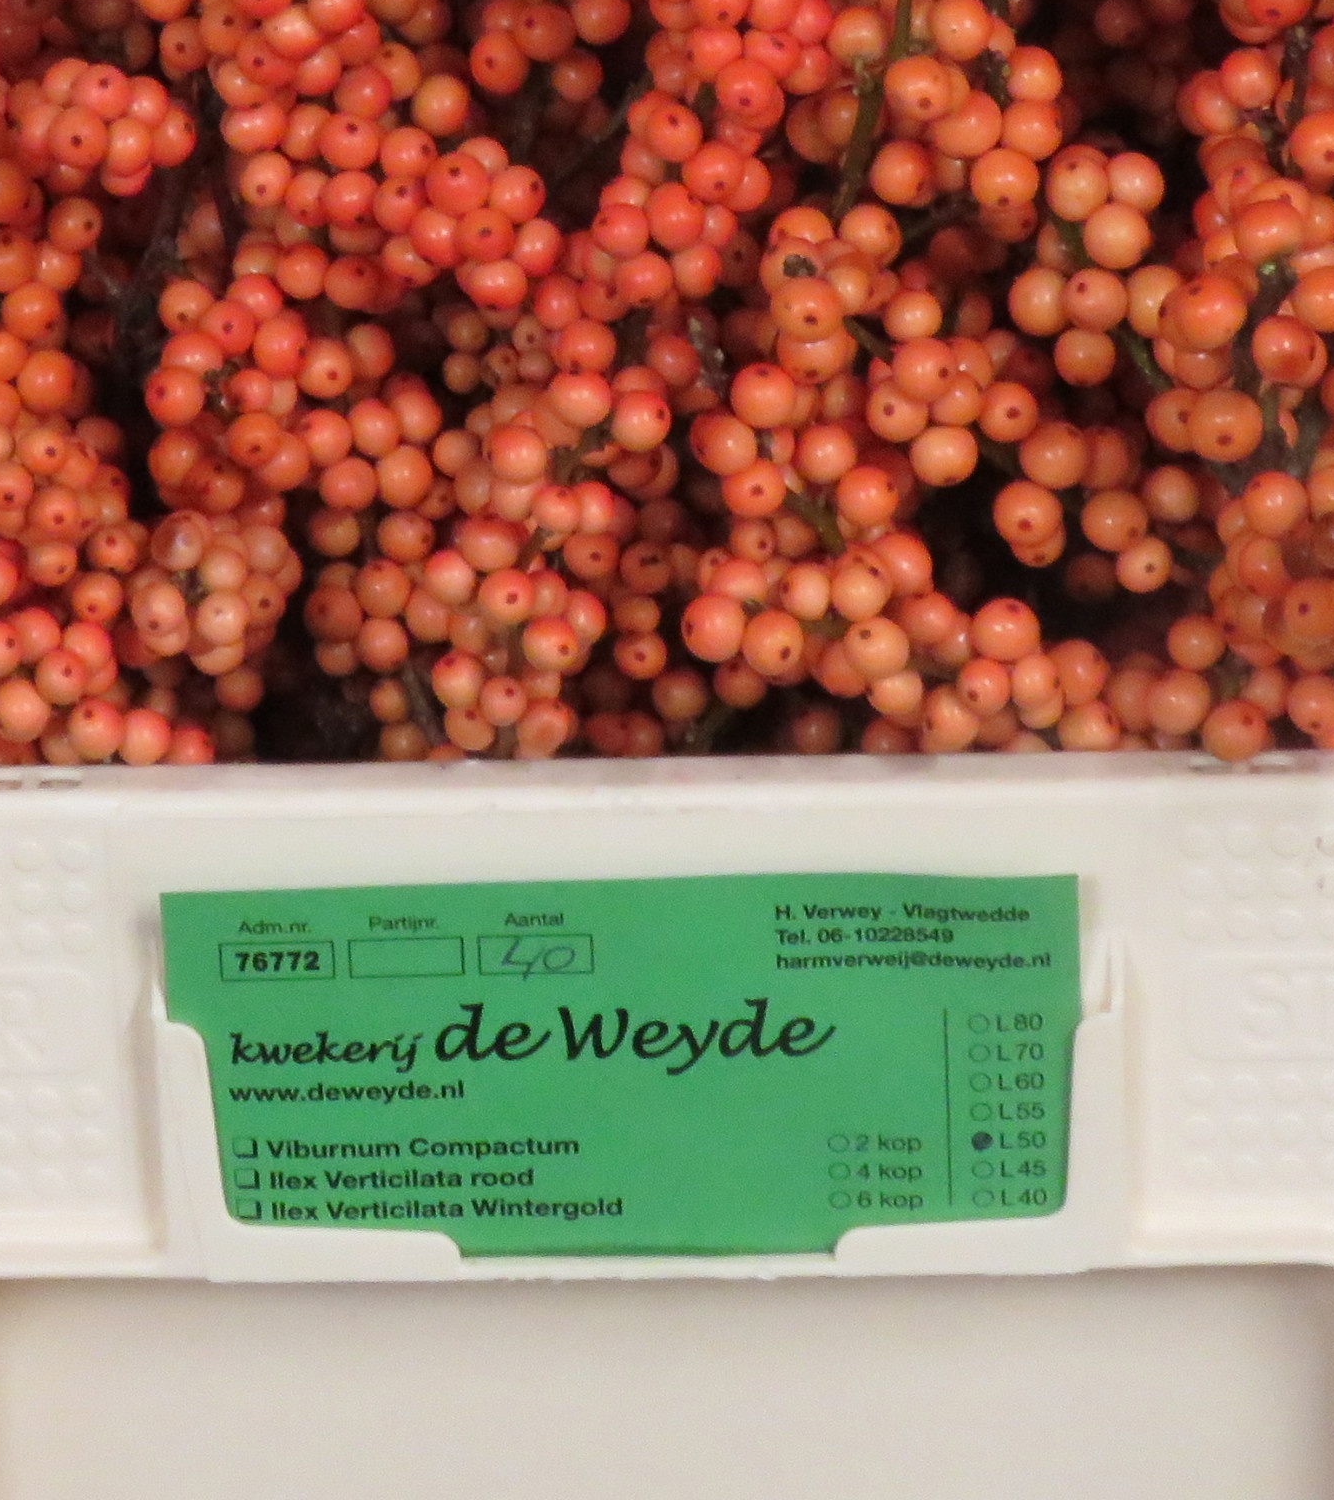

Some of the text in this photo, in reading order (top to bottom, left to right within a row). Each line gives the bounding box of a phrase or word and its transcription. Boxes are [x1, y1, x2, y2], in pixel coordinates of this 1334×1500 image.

[504, 912, 564, 928] Aantal
[775, 904, 797, 921] H.
[803, 903, 881, 921] Verwey
[902, 902, 1030, 923] Vlagtwedde
[775, 929, 811, 945] Tel.
[234, 950, 320, 972] 76772
[501, 937, 575, 980] 40
[776, 951, 1051, 972] harmverweij@deweyde.nl
[229, 997, 837, 1076] kwekerij de Weyde
[229, 1080, 465, 1105] www.deweyde.nl
[267, 1136, 580, 1160] Viburnum Compactum
[856, 1134, 922, 1154] 2 kop
[270, 1167, 535, 1190] Ilex Verticilata rood
[857, 1163, 922, 1182] 4 kop
[272, 1196, 623, 1221] Ilex Verticilata Wintergold
[858, 1191, 924, 1211] 6 kop
